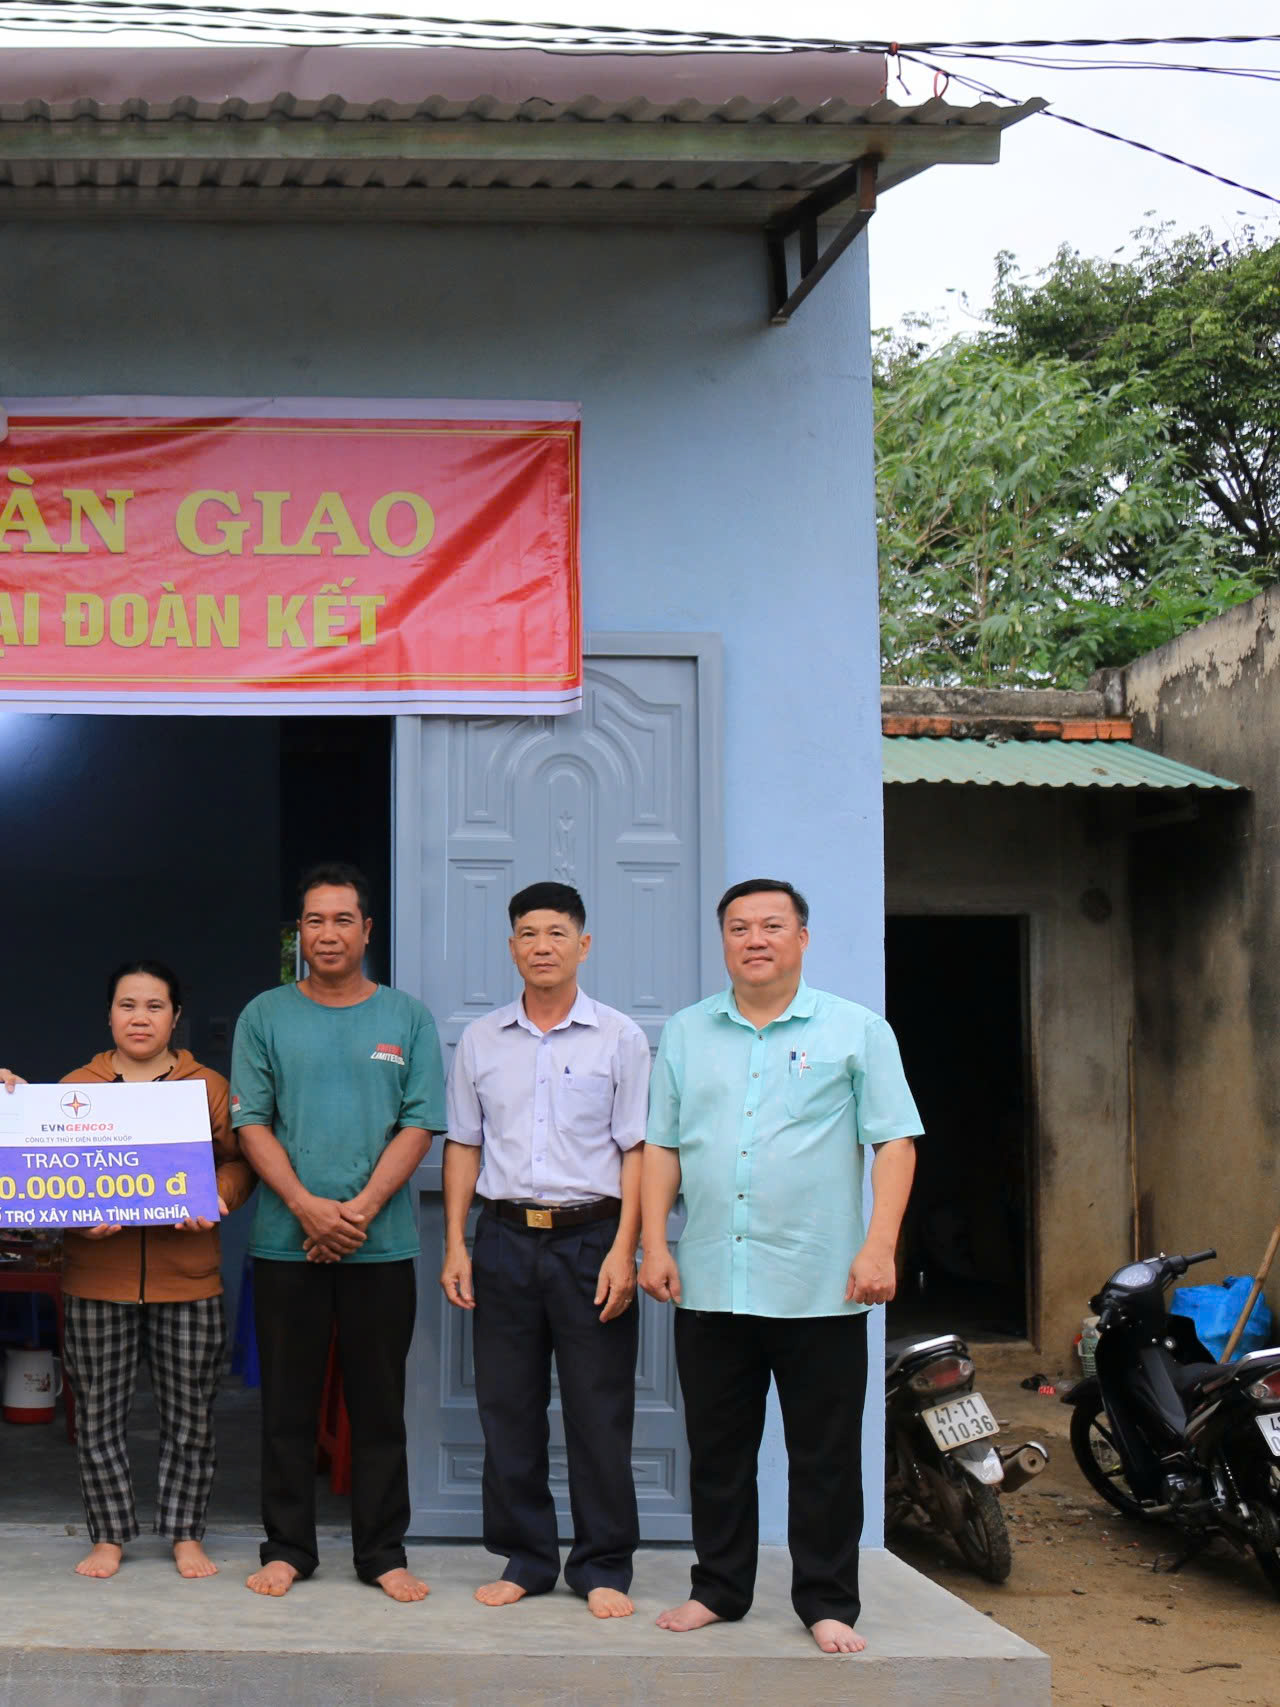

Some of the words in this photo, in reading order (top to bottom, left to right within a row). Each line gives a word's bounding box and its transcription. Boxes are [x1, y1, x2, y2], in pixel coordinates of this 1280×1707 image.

[175, 489, 435, 557] GIAO
[61, 582, 240, 648] ĐOÀN
[267, 577, 386, 649] KẾT
[41, 1123, 114, 1132] EVNGENCO3
[21, 1152, 80, 1169] TRAO
[81, 1149, 140, 1171] TẶNG
[165, 1171, 188, 1196] đ
[4, 1207, 36, 1226] TRỢ
[39, 1207, 69, 1223] XÂY
[72, 1206, 104, 1222] NHÀ
[106, 1205, 141, 1221] TÌNH
[143, 1203, 191, 1220] NGHĨA
[937, 1414, 995, 1446] 110.36
